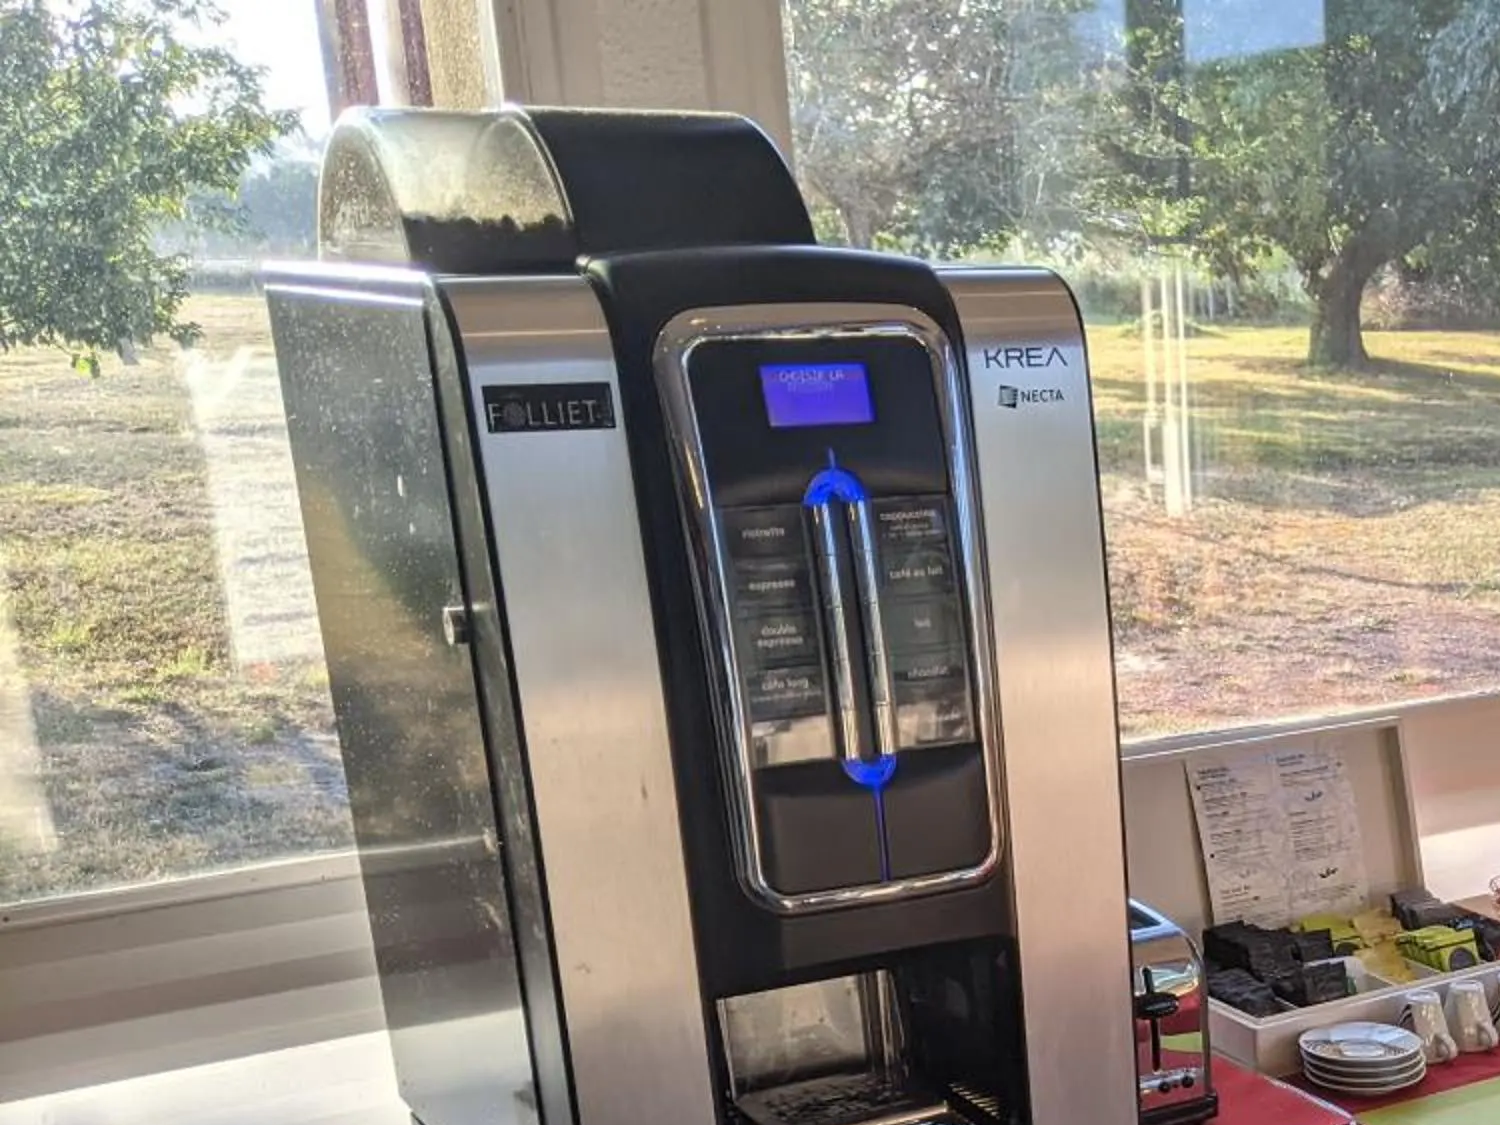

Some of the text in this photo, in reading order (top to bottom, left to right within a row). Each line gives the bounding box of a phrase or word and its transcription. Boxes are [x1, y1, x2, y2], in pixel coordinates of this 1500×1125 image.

[983, 346, 1068, 369] KREA
[1020, 388, 1065, 403] NECTA
[487, 400, 597, 433] FOLLIET
